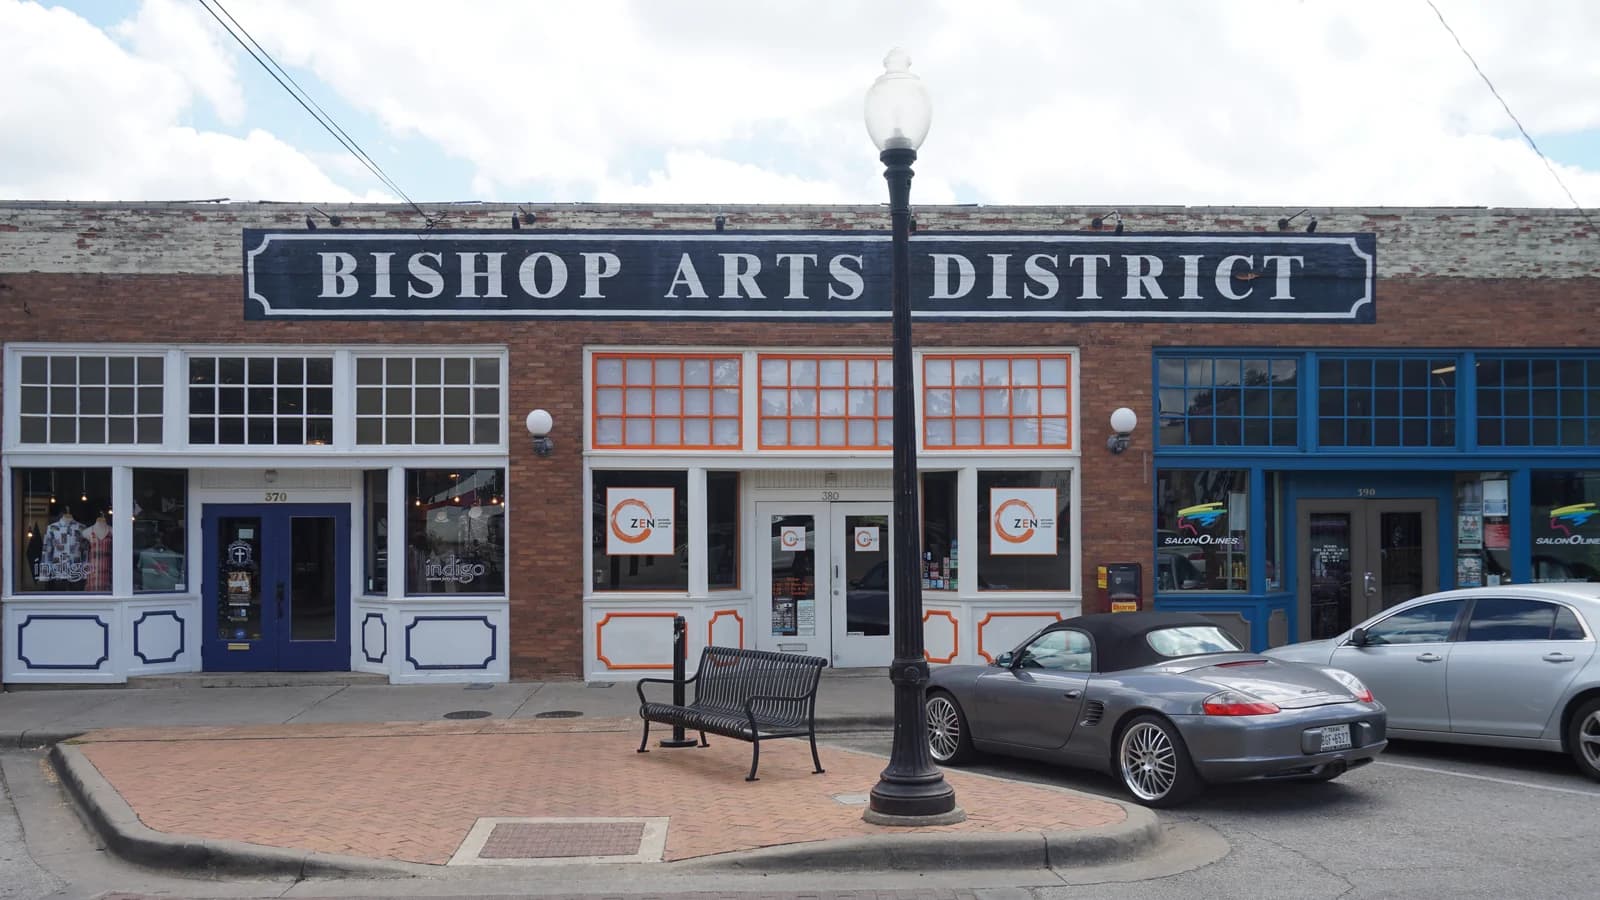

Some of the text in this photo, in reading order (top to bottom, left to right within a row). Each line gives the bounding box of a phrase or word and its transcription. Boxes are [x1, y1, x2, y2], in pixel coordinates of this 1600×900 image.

[317, 251, 1305, 300] BISHOP ARTS DISTRICT
[264, 492, 288, 503] 370
[821, 491, 840, 501] 380
[1357, 488, 1376, 497] 390
[630, 518, 655, 529] ZEN
[1013, 518, 1038, 529] ZEN
[34, 553, 94, 582] indigo
[425, 554, 485, 583] indigo
